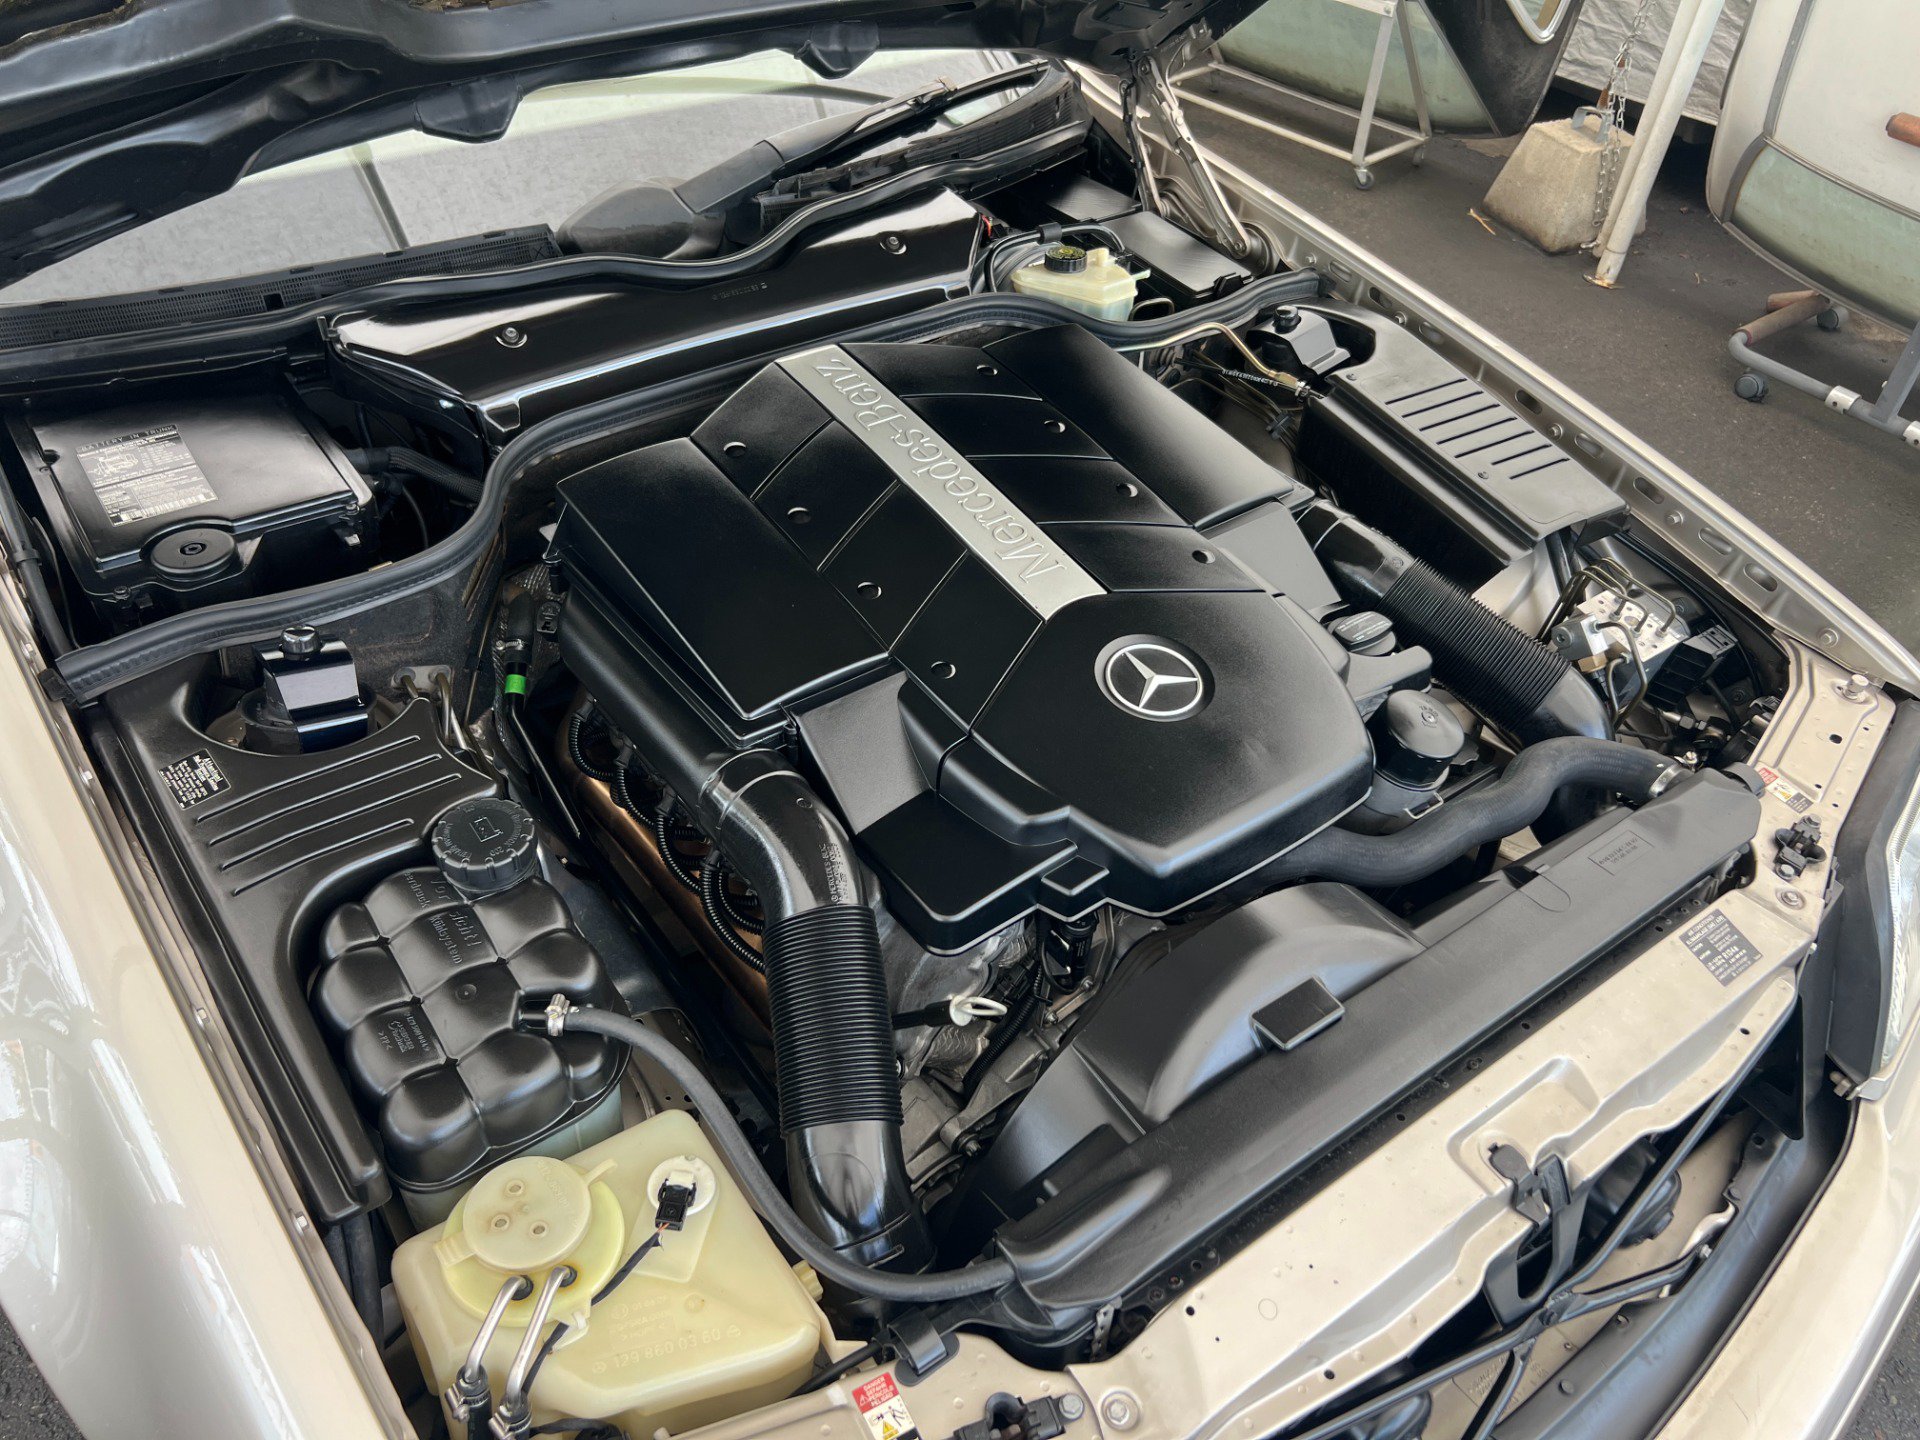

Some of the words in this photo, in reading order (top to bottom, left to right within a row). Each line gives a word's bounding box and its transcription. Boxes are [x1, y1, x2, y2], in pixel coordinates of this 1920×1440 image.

[130, 432, 140, 440] IN
[146, 425, 174, 437] TRUNK
[812, 358, 1067, 583] Mercedes-Benz
